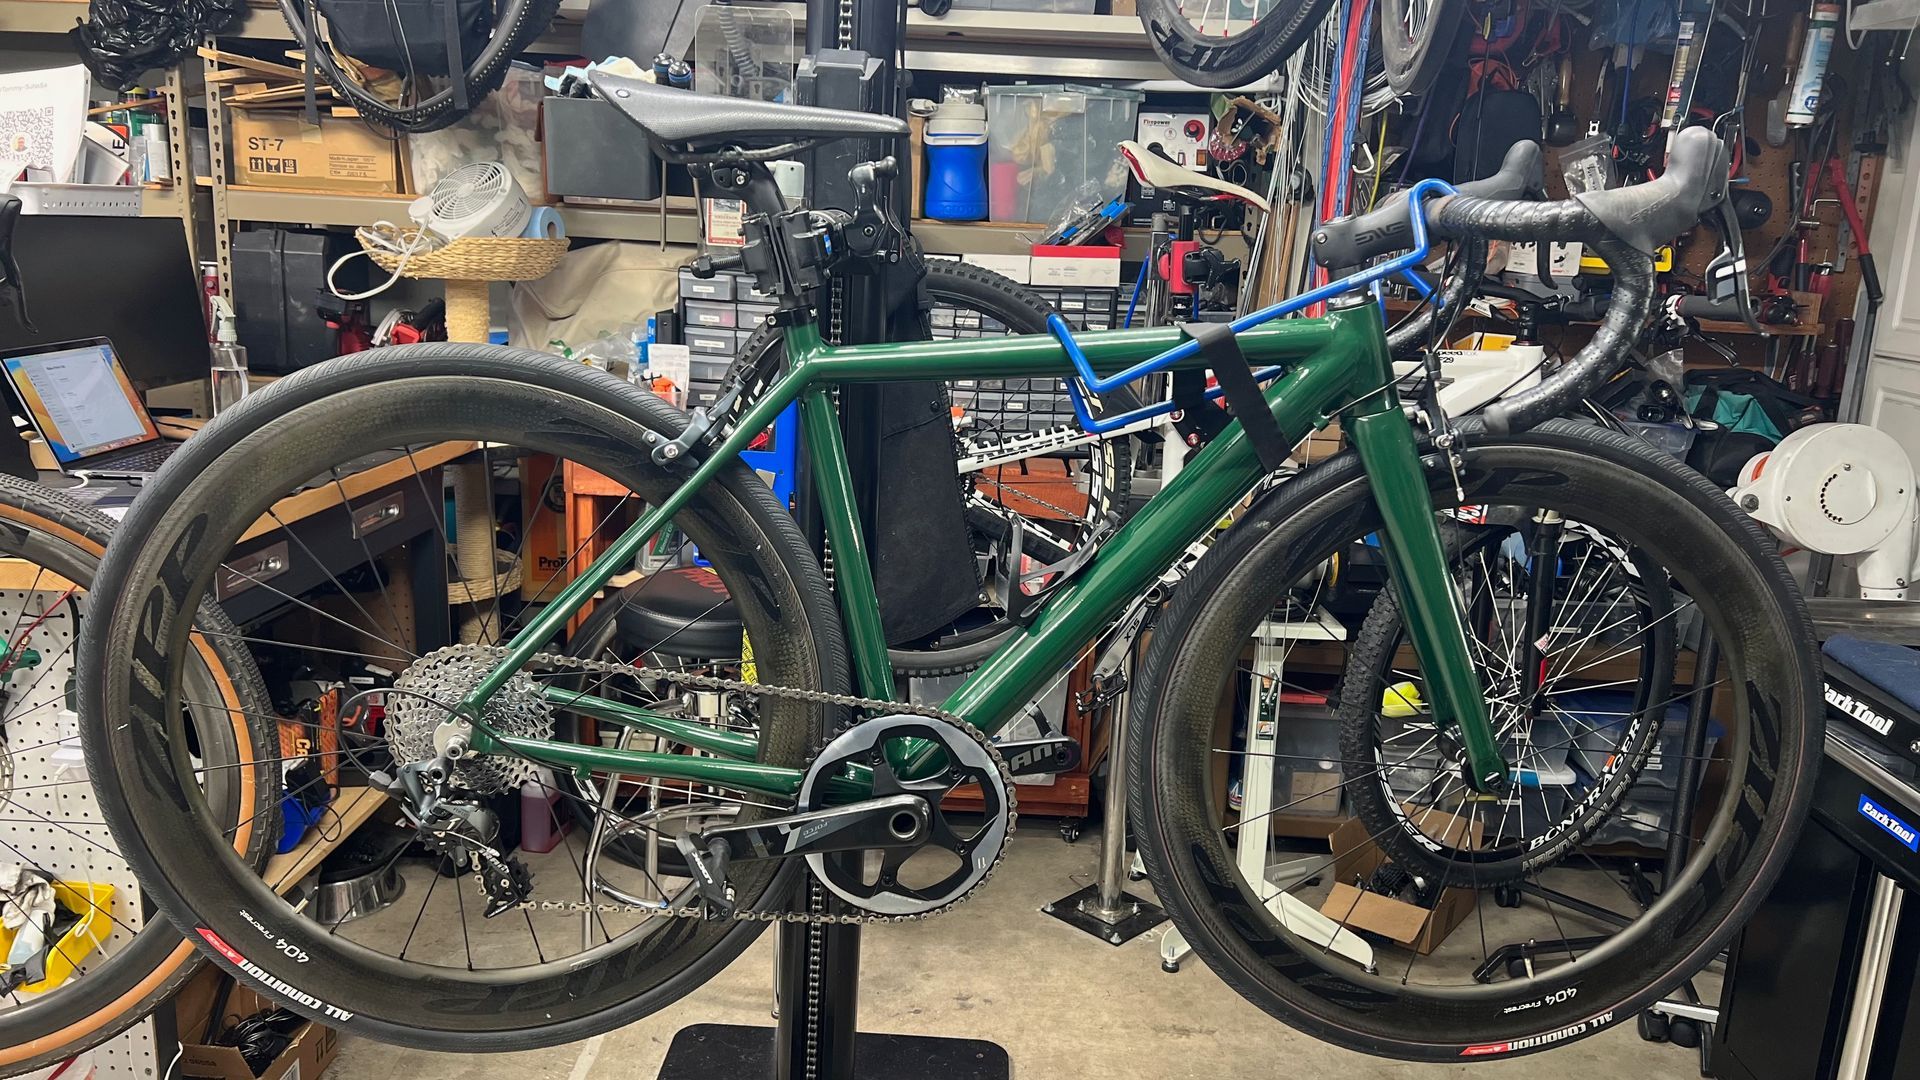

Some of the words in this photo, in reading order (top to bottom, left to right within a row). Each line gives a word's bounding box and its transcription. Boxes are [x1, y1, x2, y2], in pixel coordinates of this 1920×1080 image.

[1143, 119, 1171, 127] Firepower
[248, 136, 284, 151] ST-7
[1123, 617, 1140, 642] SLX
[1528, 717, 1642, 852] BONTRAGER
[691, 852, 713, 885] LOOK
[239, 909, 276, 940] Firecrest
[275, 938, 310, 964] 404
[238, 959, 323, 1010] CONDITION
[1544, 987, 1578, 1006] 404
[324, 1004, 354, 1022] ALL
[1503, 1000, 1542, 1015] Firecrest
[1589, 1010, 1614, 1028] ALL
[1507, 1024, 1588, 1051] CONDITION
